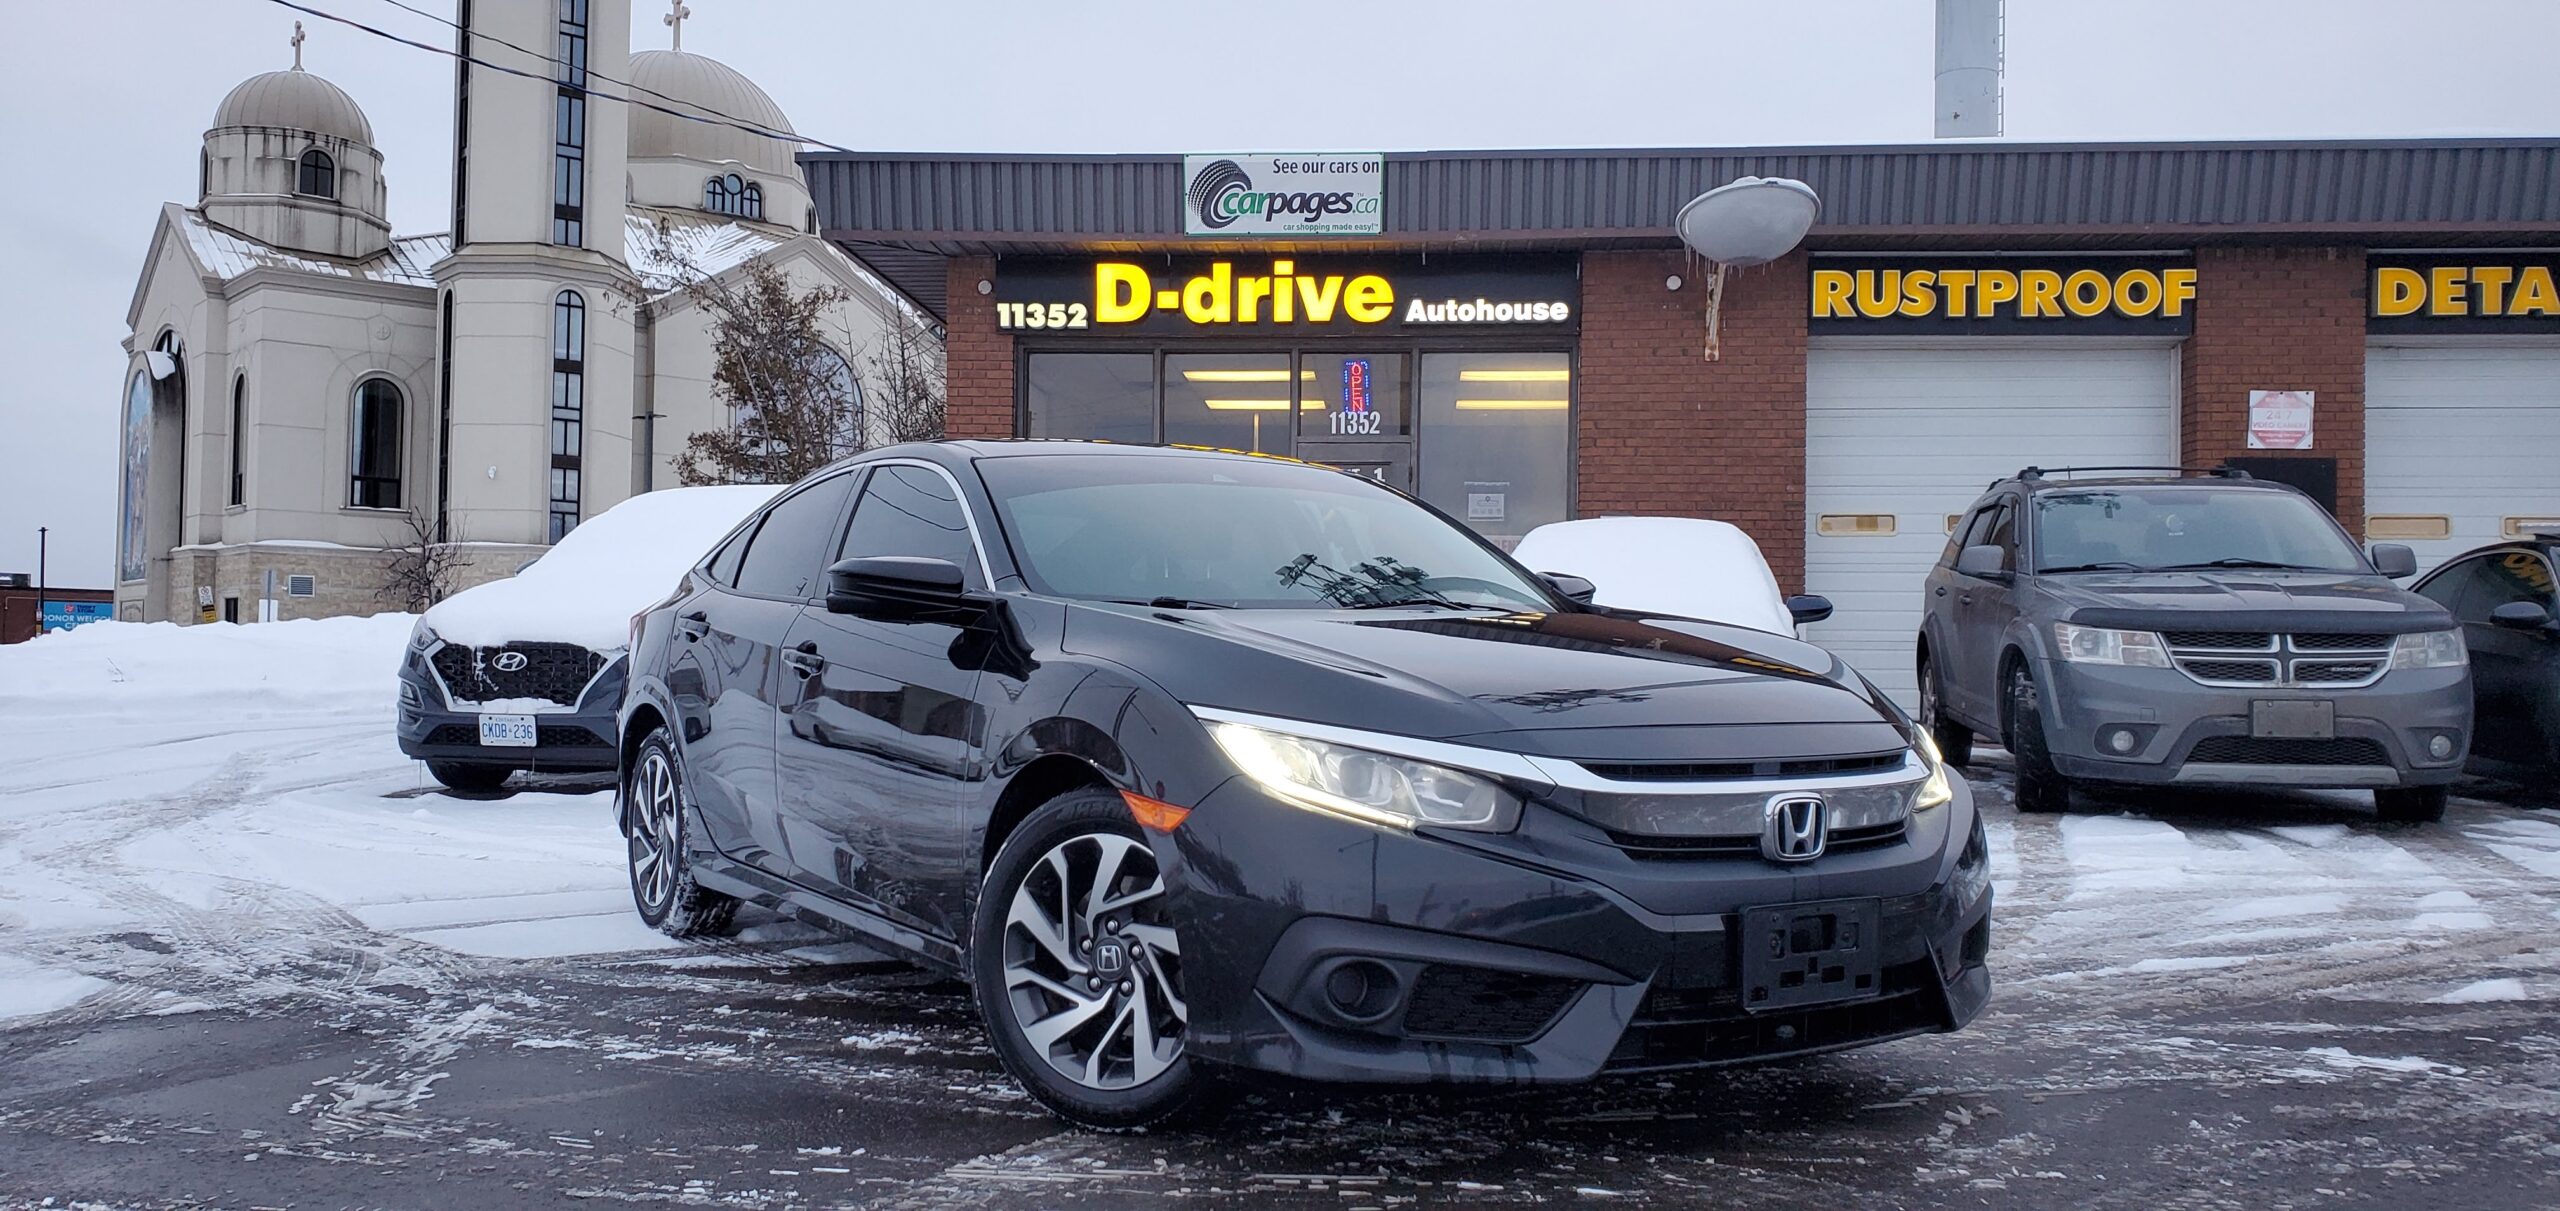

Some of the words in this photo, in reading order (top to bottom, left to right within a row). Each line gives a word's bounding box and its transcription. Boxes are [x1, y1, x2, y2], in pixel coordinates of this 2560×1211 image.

[1272, 158, 1298, 174] See
[1302, 161, 1326, 174] our
[1329, 161, 1359, 174] cars
[1362, 161, 1380, 174] on
[1296, 223, 1331, 232] shopping
[1332, 223, 1353, 231] made
[997, 303, 1088, 330] 11352
[1096, 260, 1395, 324] D-drive
[1404, 299, 1570, 323] Autohouse
[1812, 269, 2197, 318] RUSTPROOF
[2377, 266, 2560, 316] DETA
[1351, 363, 1364, 412] OPEN
[1329, 411, 1381, 434] 11352
[1373, 467, 1386, 482] 1
[43, 614, 75, 622] DONOR
